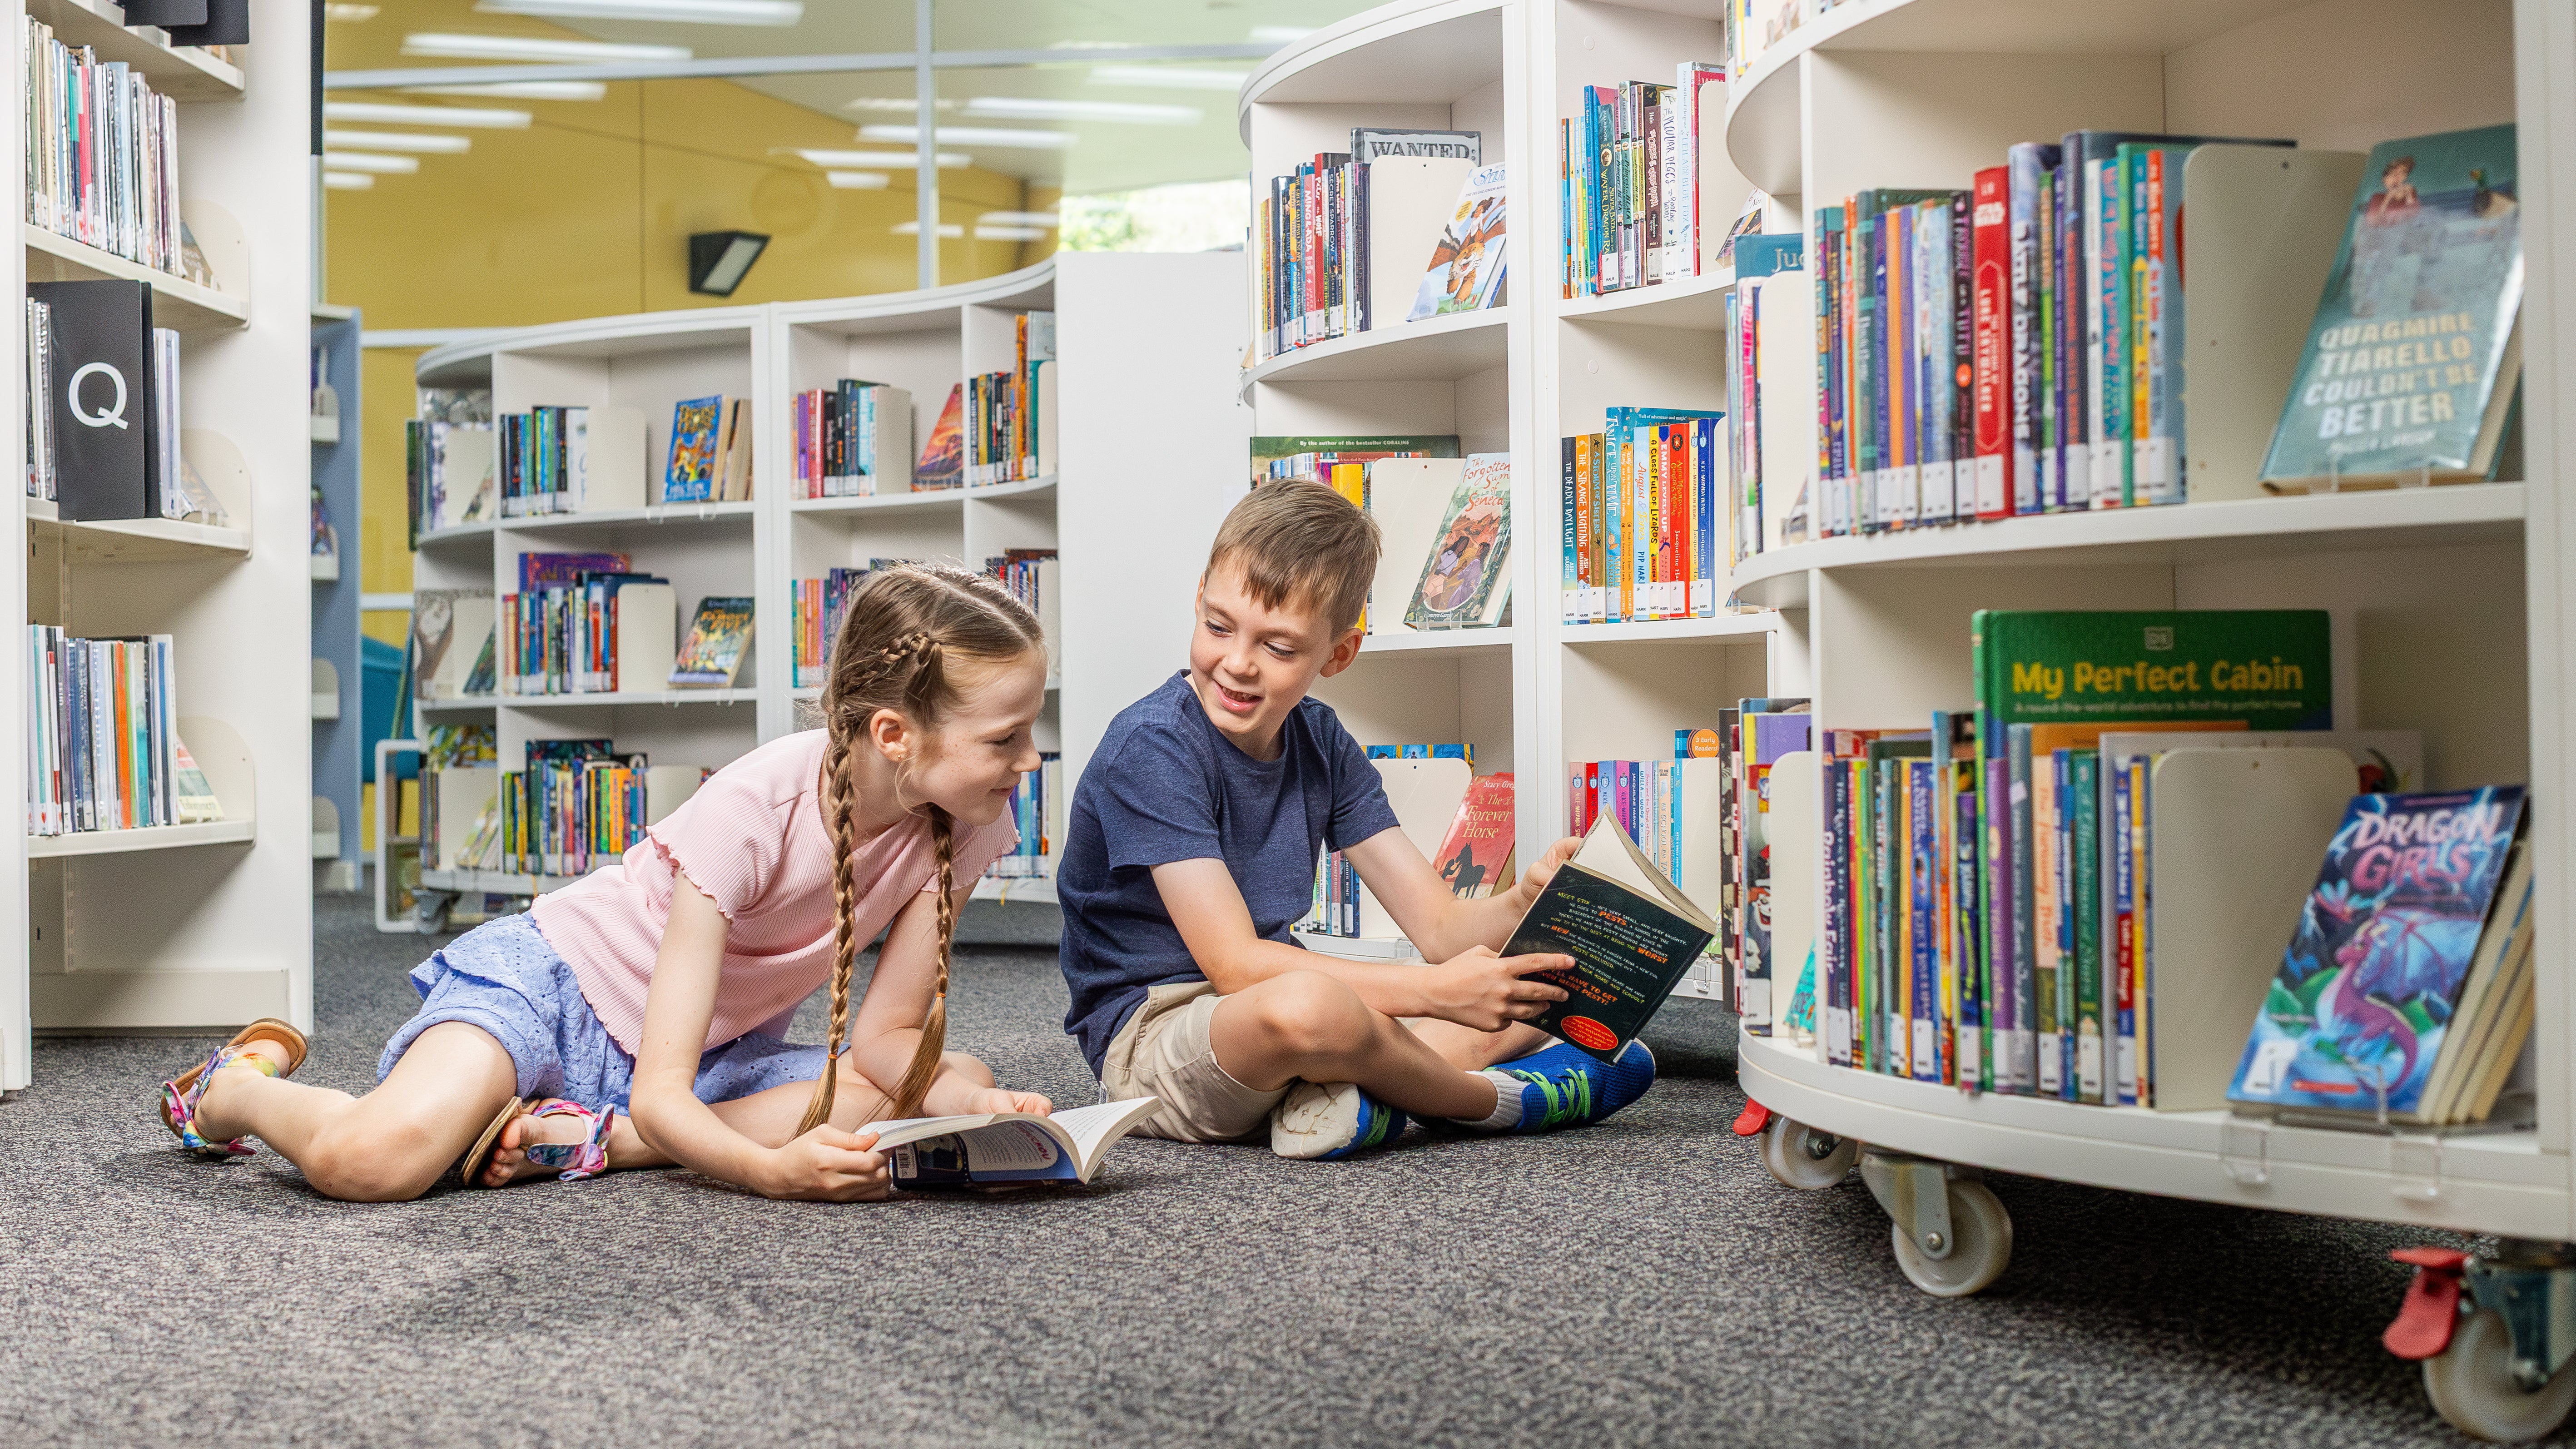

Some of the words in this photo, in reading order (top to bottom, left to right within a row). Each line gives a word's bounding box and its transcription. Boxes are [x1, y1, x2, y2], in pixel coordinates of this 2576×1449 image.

[1664, 116, 1676, 156] PECULIAR
[2319, 312, 2473, 350] QUAGMIRE
[2319, 336, 2472, 377] TIARELLO
[69, 362, 129, 430] Q
[2303, 367, 2438, 407] COULDN'T
[2444, 363, 2478, 386] BE
[2319, 391, 2454, 440] BETTER
[1606, 416, 1618, 459] TWICE
[1463, 461, 1510, 486] Forgotten
[1472, 458, 1484, 468] The
[1578, 452, 1586, 467] THE
[1491, 482, 1499, 494] of
[1578, 471, 1587, 506] STRANGE
[1635, 462, 1646, 499] August
[1465, 492, 1504, 511] Seneca
[1595, 491, 1600, 499] OF
[1606, 481, 1619, 516] TIME
[1652, 496, 1657, 505] OF
[1565, 509, 1573, 549] DAYLIGHT
[1578, 510, 1587, 547] SIGHTING
[1638, 511, 1647, 540] Jones
[1661, 516, 1667, 532] UP
[2012, 661, 2065, 700] My
[2073, 660, 2201, 693] Perfect
[2210, 656, 2303, 691] Cabin
[1484, 780, 1500, 790] Stacy
[1465, 805, 1512, 821] Forever
[1488, 794, 1502, 805] The
[1462, 822, 1499, 839] Horse
[2353, 802, 2504, 849] DRAGON
[2353, 844, 2471, 890] GIRLS
[1557, 892, 1575, 900] MEET
[1665, 933, 1687, 945] NAUGHTY.
[1569, 909, 1594, 920] BASEMENT
[1614, 925, 1634, 936] BUILDING
[1635, 927, 1651, 937] SCHOOL
[1572, 945, 1589, 955] PESTS
[1589, 954, 1614, 969] INCLUDED.
[1603, 928, 1618, 936] PESTY
[1619, 934, 1638, 945] FRIENDS
[1650, 947, 1668, 958] TAUGHT
[1611, 936, 1625, 946] BEING
[1637, 947, 1668, 964] WORST
[1578, 965, 1592, 976] THEIR
[1594, 973, 1609, 984] HOME
[1590, 985, 1601, 993] TO
[1602, 992, 1618, 1002] GET
